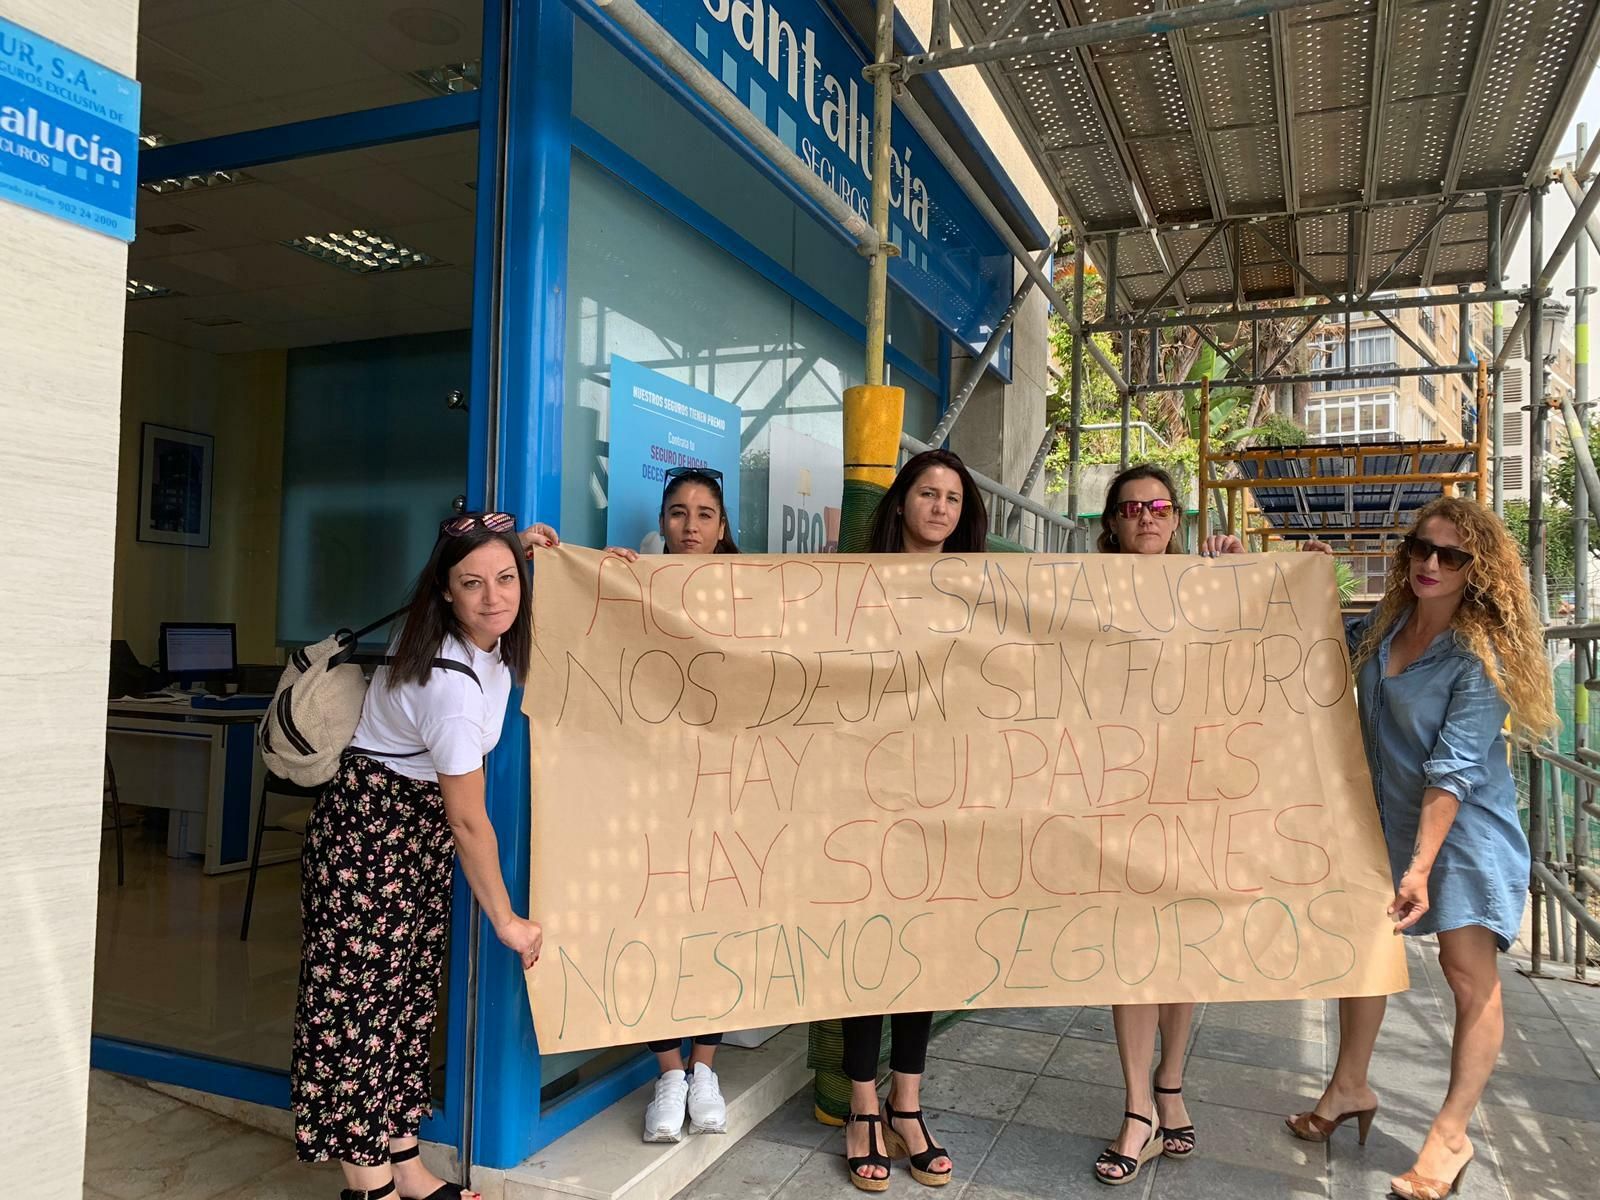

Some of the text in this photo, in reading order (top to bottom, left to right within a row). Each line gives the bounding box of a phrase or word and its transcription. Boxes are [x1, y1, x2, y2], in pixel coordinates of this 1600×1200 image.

[46, 80, 107, 116] EXCLUSIVA
[109, 109, 124, 123] DE
[52, 57, 97, 95] S.A.
[802, 137, 869, 225] SEGUROS
[58, 200, 77, 214] 902
[80, 208, 91, 219] 24
[95, 213, 118, 229] 2000
[632, 386, 726, 431] NUESTROS SEGUROS TIENEN PREMIO
[651, 445, 677, 466] SEGURO
[678, 453, 687, 467] DE
[556, 634, 1348, 729] NOS DEJAN SIN FUTURO
[687, 722, 1264, 818] HAY CULPABLES
[634, 804, 1331, 919] HAY SOLUCIONES
[558, 890, 1355, 1040] NO ESTAMOS SEGUROS
